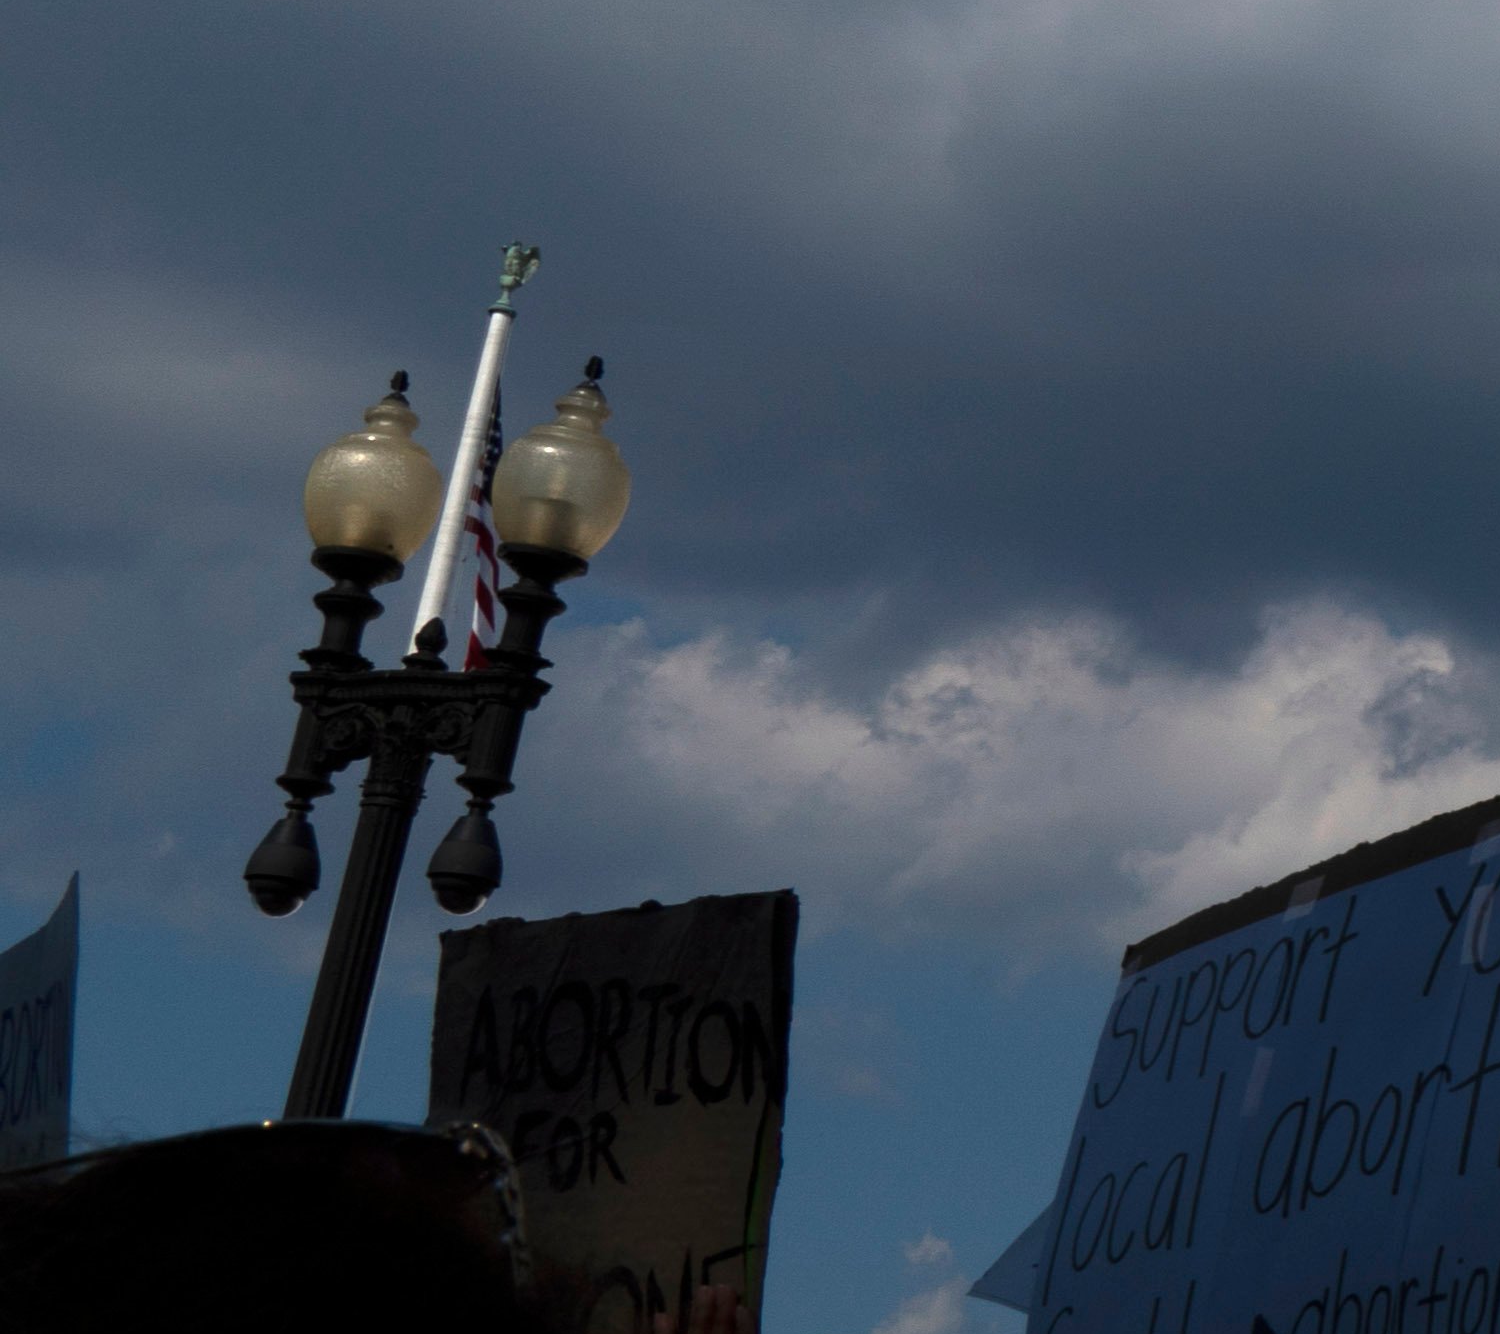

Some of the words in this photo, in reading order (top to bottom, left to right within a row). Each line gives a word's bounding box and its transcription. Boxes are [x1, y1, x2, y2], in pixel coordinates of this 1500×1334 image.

[459, 977, 787, 1107] ABORTION
[515, 1109, 626, 1193] FOR
[1040, 1071, 1226, 1308] local
